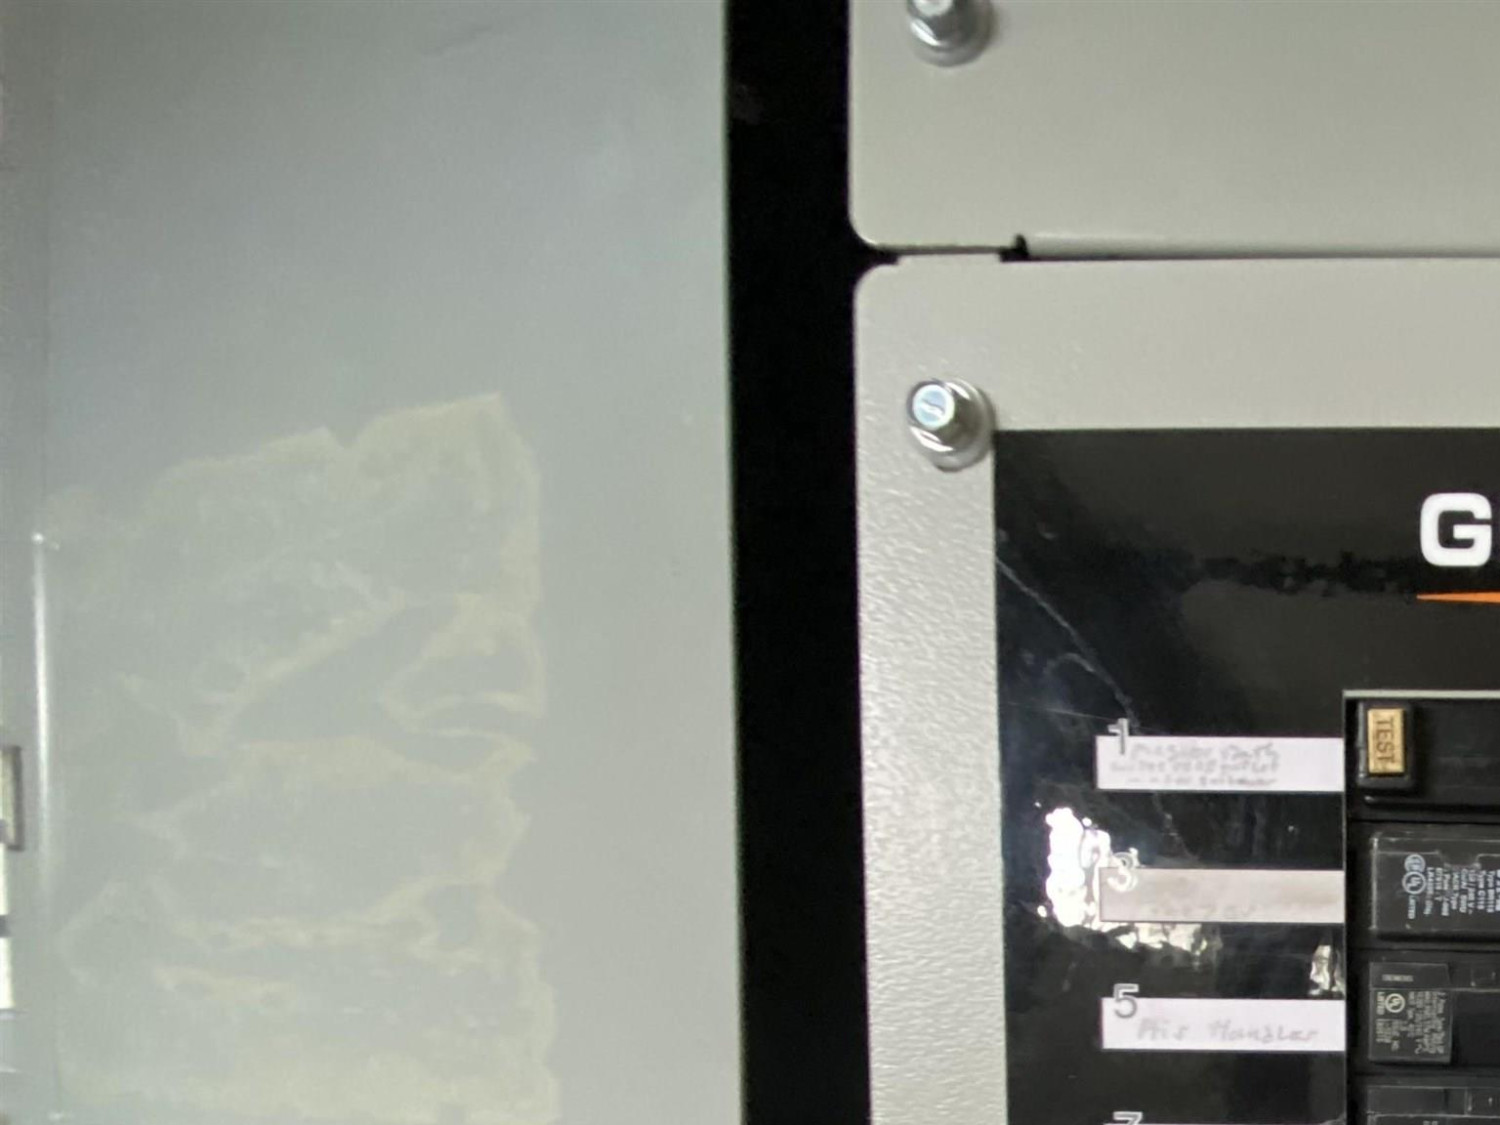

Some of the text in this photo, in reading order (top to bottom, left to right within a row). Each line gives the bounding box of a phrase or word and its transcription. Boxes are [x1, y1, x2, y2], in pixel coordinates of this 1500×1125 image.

[1107, 718, 1129, 755] 1
[1375, 716, 1395, 764] TEST
[1113, 983, 1139, 1019] 5
